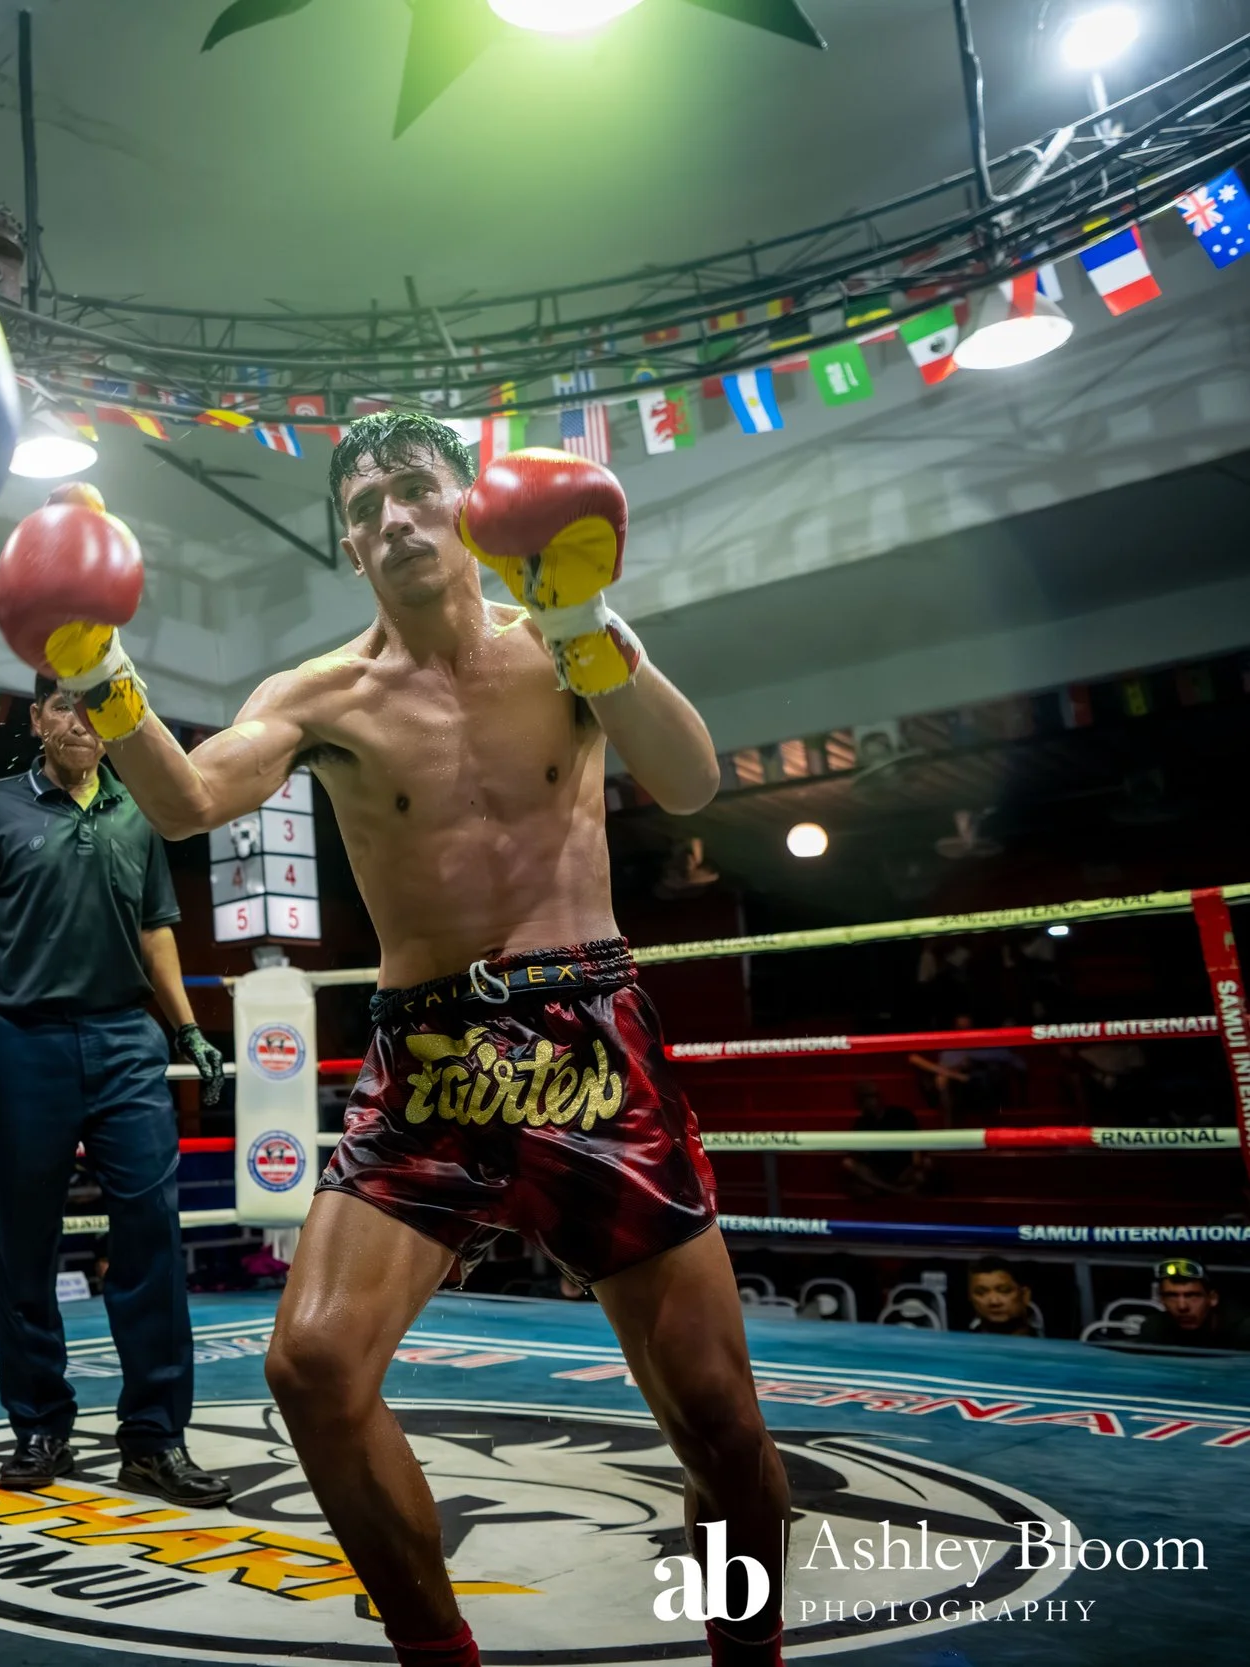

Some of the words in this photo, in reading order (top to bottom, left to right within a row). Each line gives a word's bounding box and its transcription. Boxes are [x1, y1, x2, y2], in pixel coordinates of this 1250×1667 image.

[283, 820, 295, 842] 3
[285, 864, 296, 887] 4
[236, 908, 248, 930] 5
[289, 907, 299, 930] 5
[1216, 979, 1248, 1048] SAMUI
[1031, 1022, 1100, 1040] SAMUI
[1103, 1016, 1218, 1036] INTERNATI
[1018, 1224, 1088, 1241] SAMUI
[1093, 1225, 1250, 1243] INTERNATIONA
